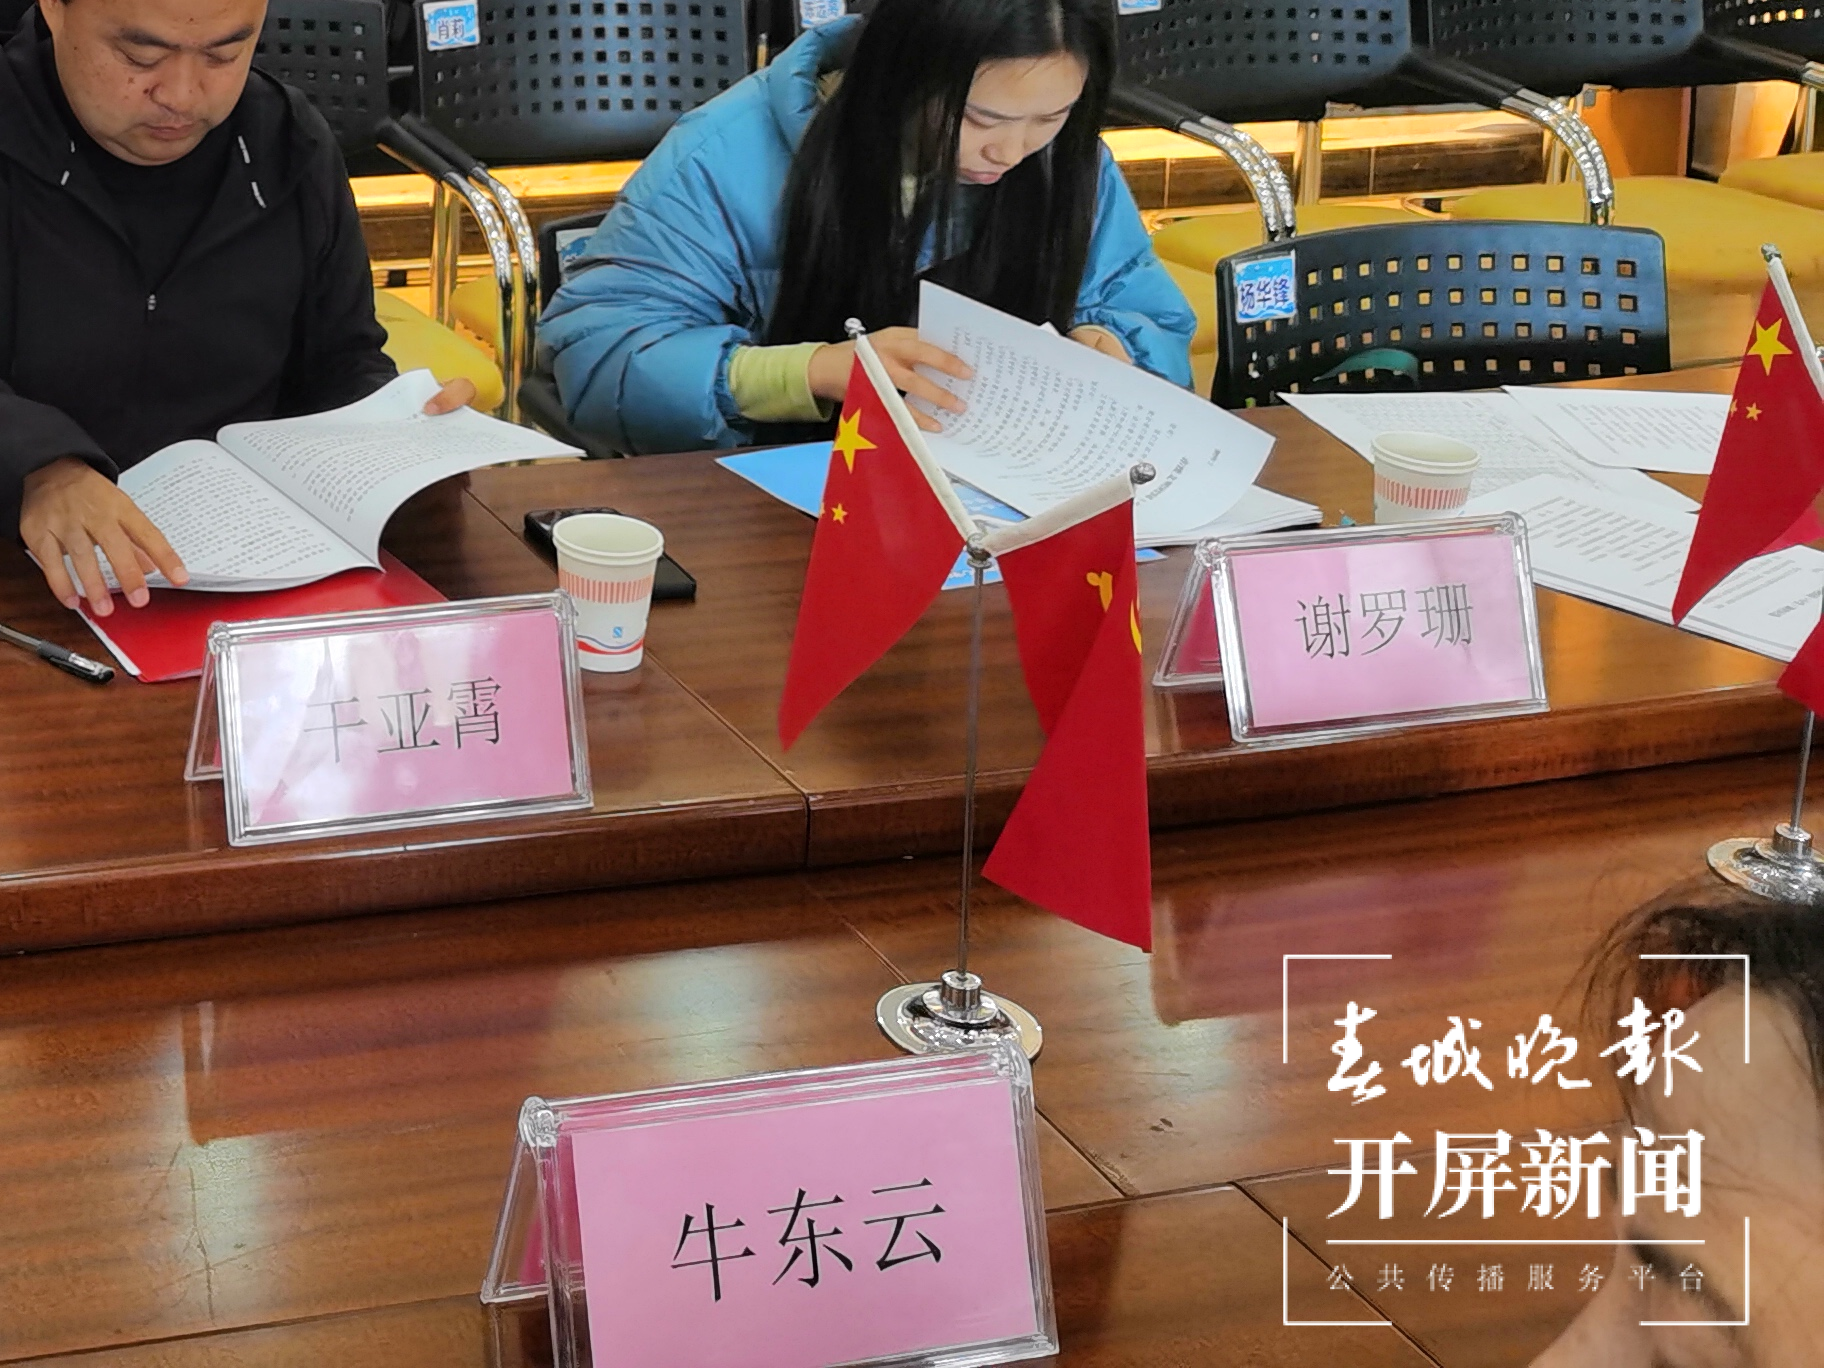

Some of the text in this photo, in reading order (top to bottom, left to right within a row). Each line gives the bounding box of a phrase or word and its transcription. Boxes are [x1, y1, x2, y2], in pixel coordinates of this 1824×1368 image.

[1295, 583, 1474, 660] 谢罗珊
[671, 1177, 946, 1303] 牛东云
